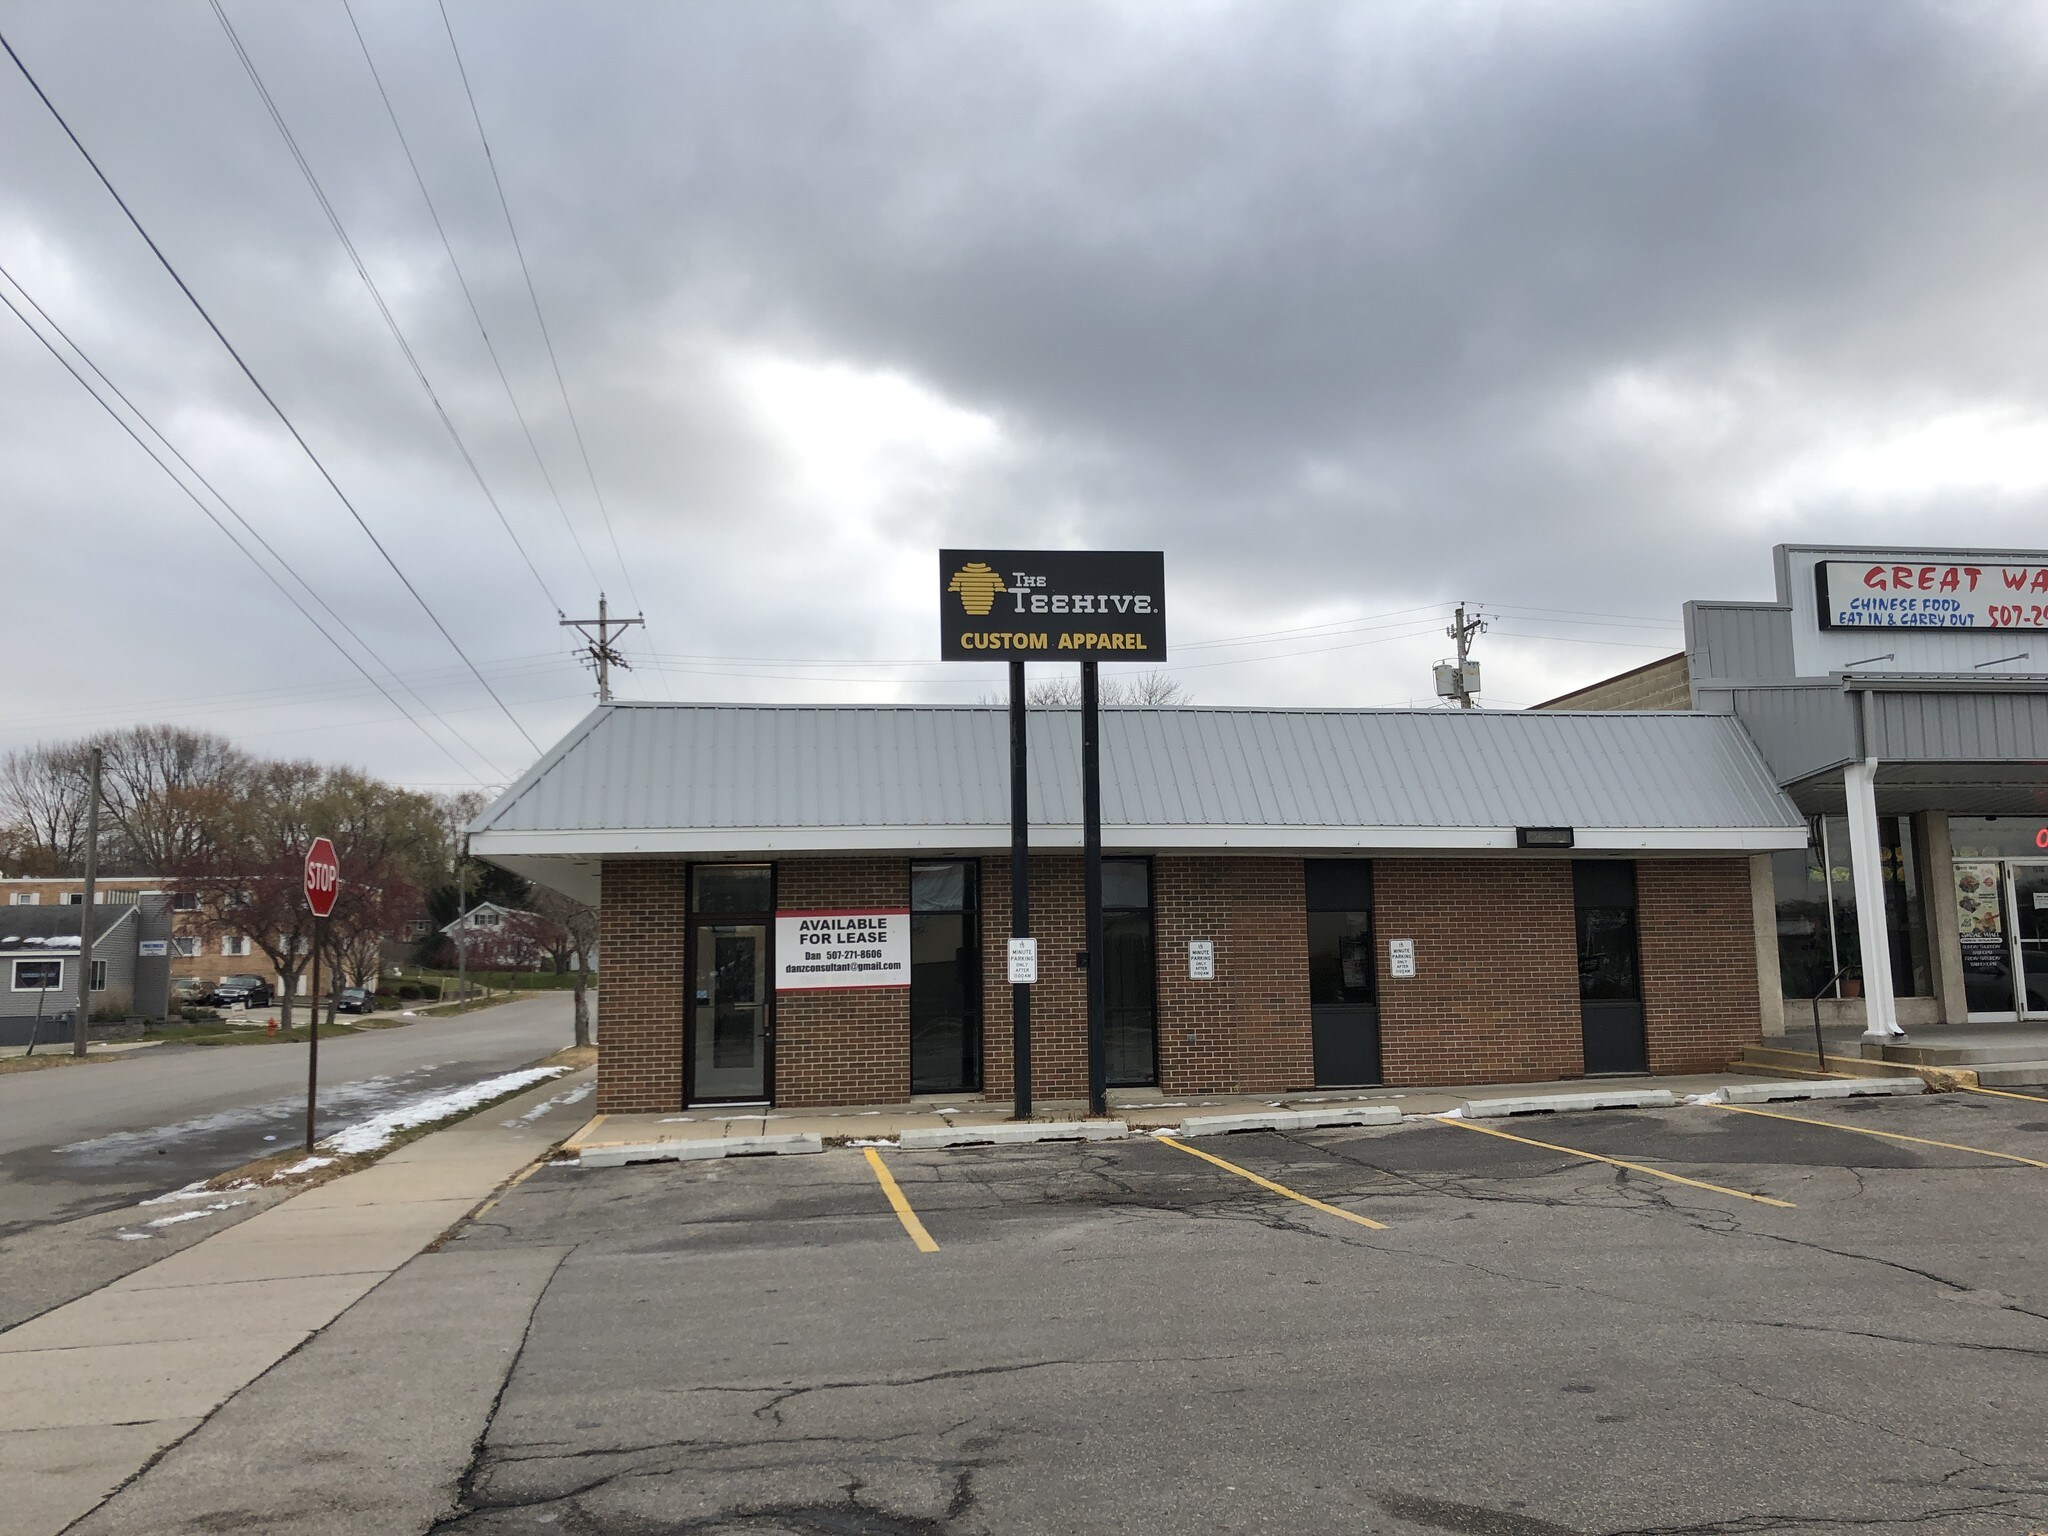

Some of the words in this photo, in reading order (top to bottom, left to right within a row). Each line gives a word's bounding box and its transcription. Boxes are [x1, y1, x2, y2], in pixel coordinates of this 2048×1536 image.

[1863, 566, 1982, 593] GREAT
[1850, 597, 1917, 611] CHINESE
[1923, 598, 1961, 612] FOOD
[1839, 612, 1863, 626] EAT
[1868, 612, 1883, 626] IN
[1887, 612, 1897, 626] &
[1900, 612, 1945, 627] CARRY
[1950, 613, 1975, 627] OUT
[960, 632, 1048, 650] CUSTOM
[1058, 633, 1147, 650] APPAREL
[307, 861, 336, 892] STOP
[799, 918, 887, 931] AVAILABLE
[800, 933, 832, 945] FOR
[837, 932, 887, 944] LEASE
[805, 951, 821, 960] Dan
[826, 949, 882, 960] 507-271-8606
[785, 961, 901, 973] danzconsultant@gmail.com
